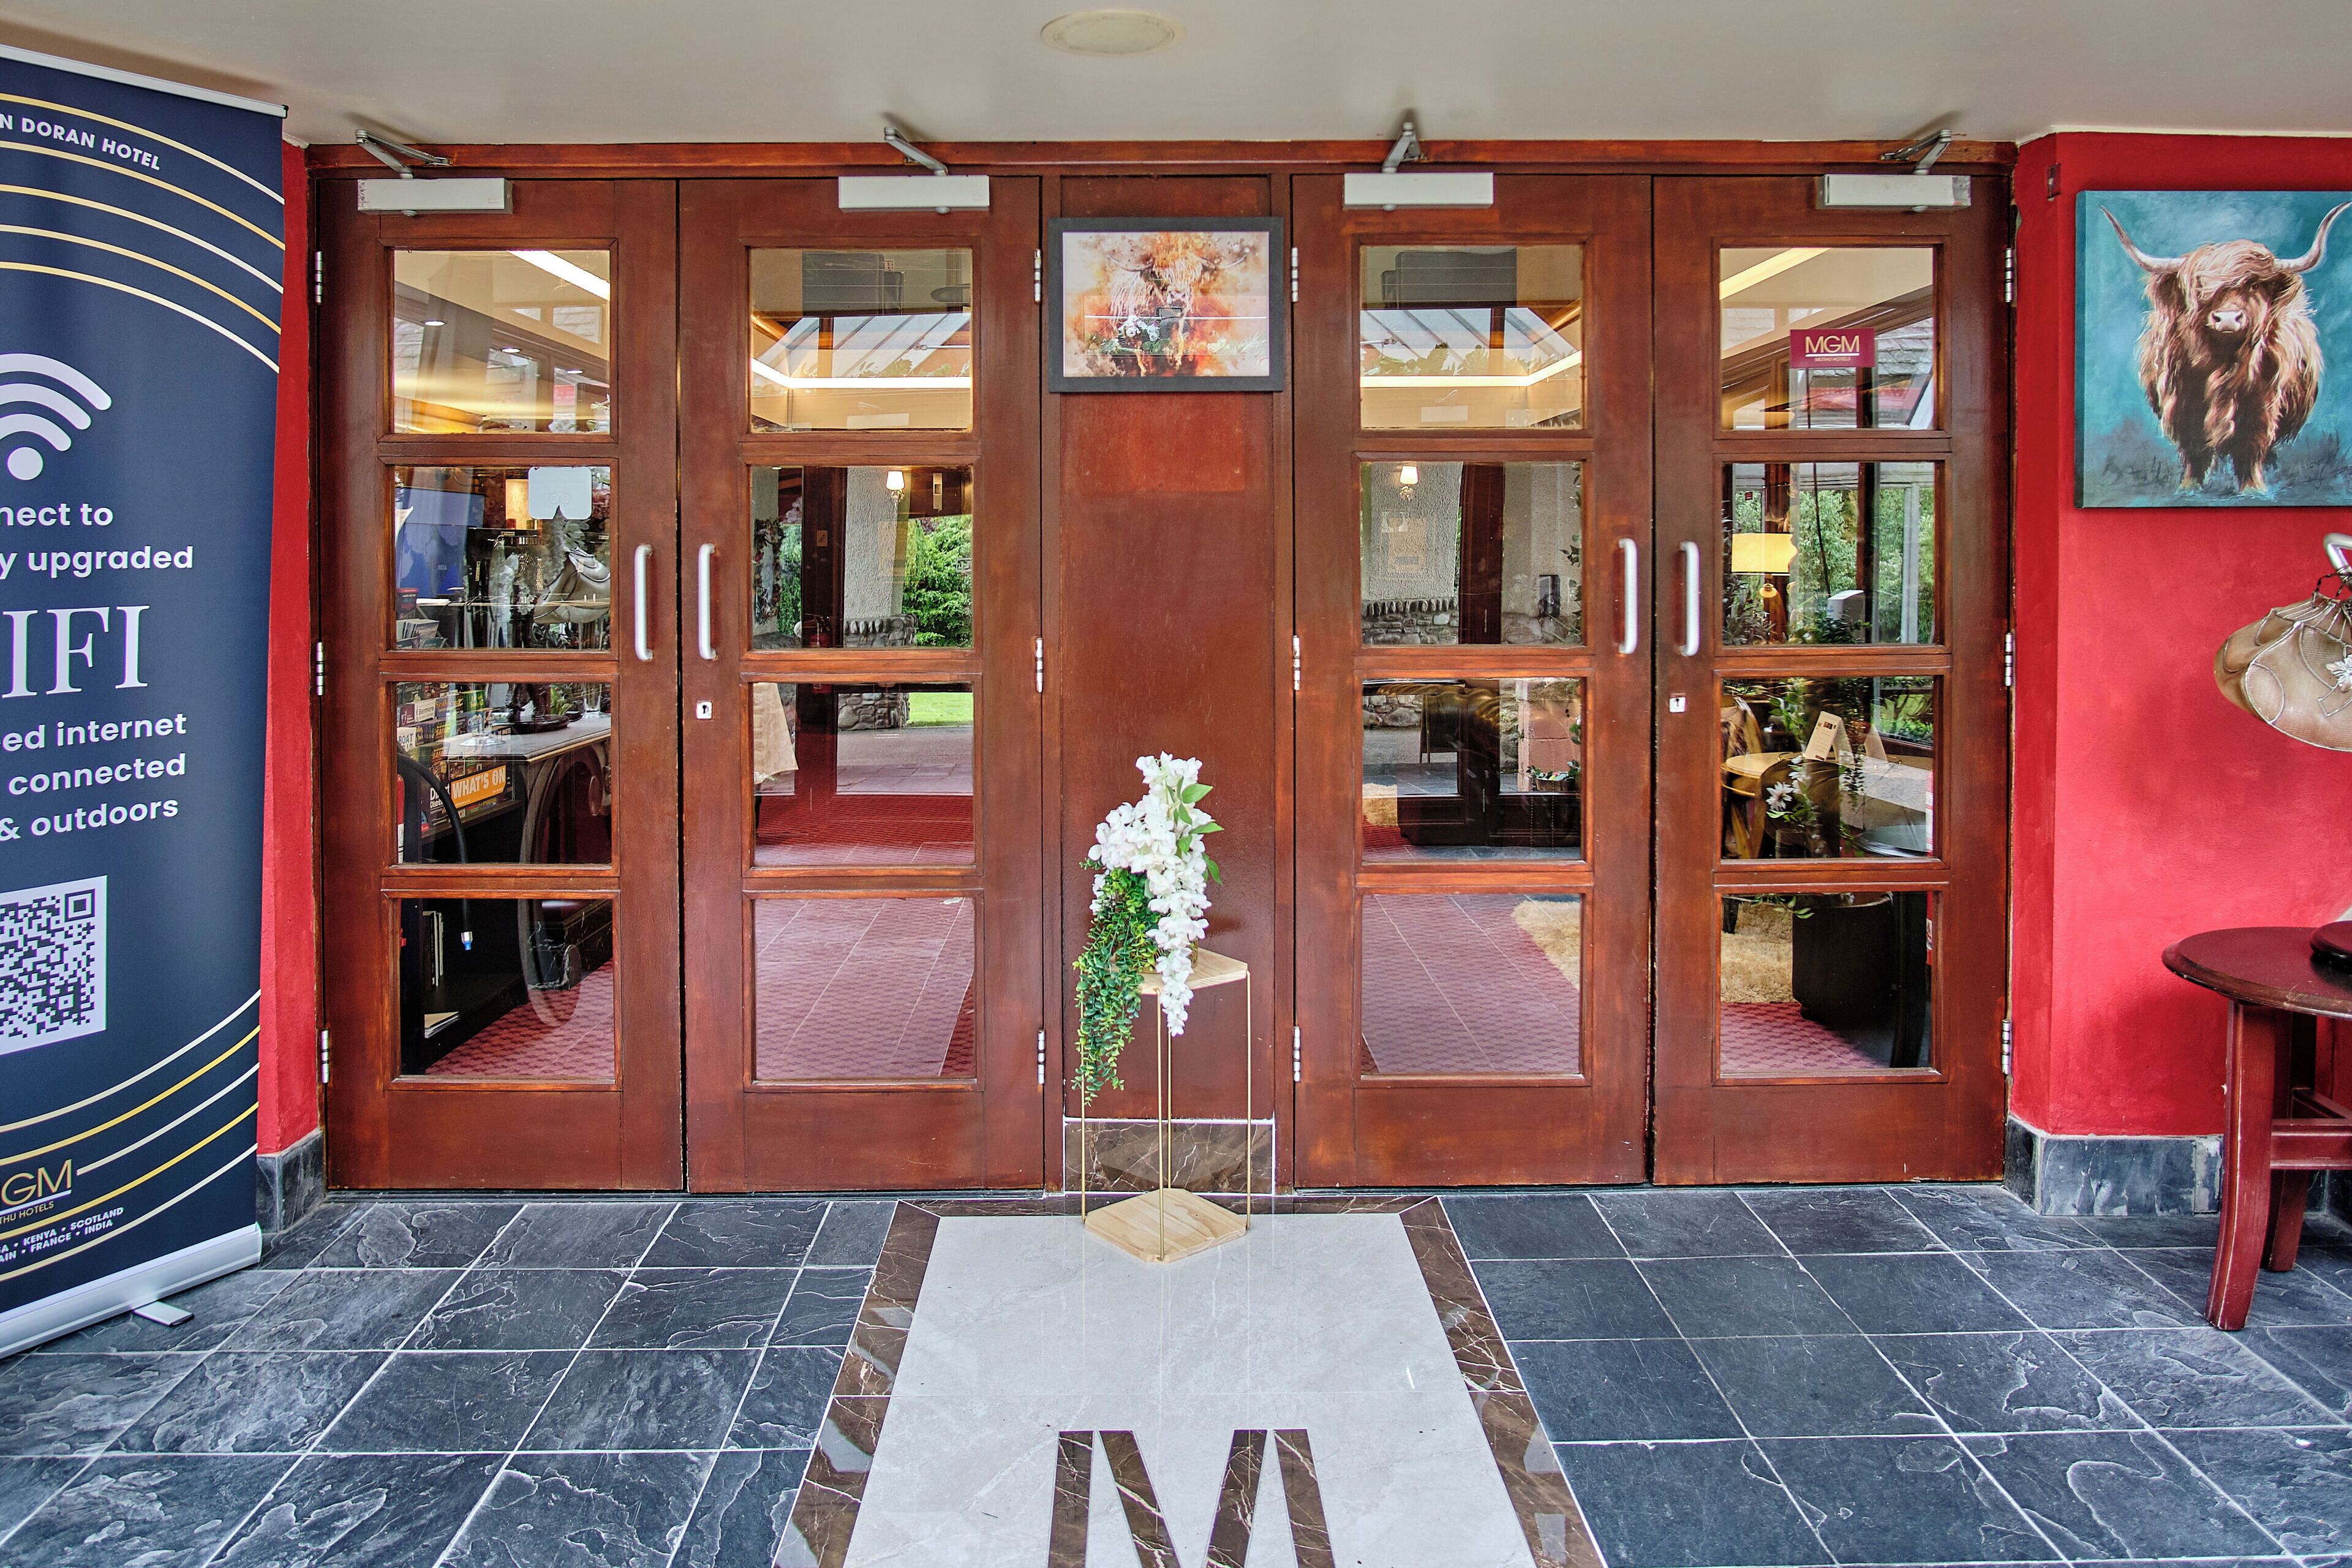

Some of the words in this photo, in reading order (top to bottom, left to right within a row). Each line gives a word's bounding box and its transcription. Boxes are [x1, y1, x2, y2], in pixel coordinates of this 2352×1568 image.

[22, 117, 96, 148] DORAN
[102, 138, 160, 171] HOTEL
[1805, 335, 1860, 353] MGM
[80, 503, 113, 526] to
[0, 552, 18, 579] y
[28, 545, 194, 578] upgraded
[2, 605, 150, 698] IFI
[57, 714, 187, 747] internet
[398, 733, 413, 745] BOAT
[9, 753, 186, 795] connected
[453, 772, 489, 799] WHAT'S
[492, 767, 506, 786] ON
[0, 817, 22, 841] &
[31, 799, 178, 836] outdoors
[1, 1158, 72, 1206] GM
[19, 1201, 55, 1219] HOTELS
[23, 1228, 58, 1246] KENYA
[70, 1207, 124, 1231] SCOTLAND
[30, 1232, 72, 1253] FRANCE
[85, 1219, 114, 1235] INDIA
